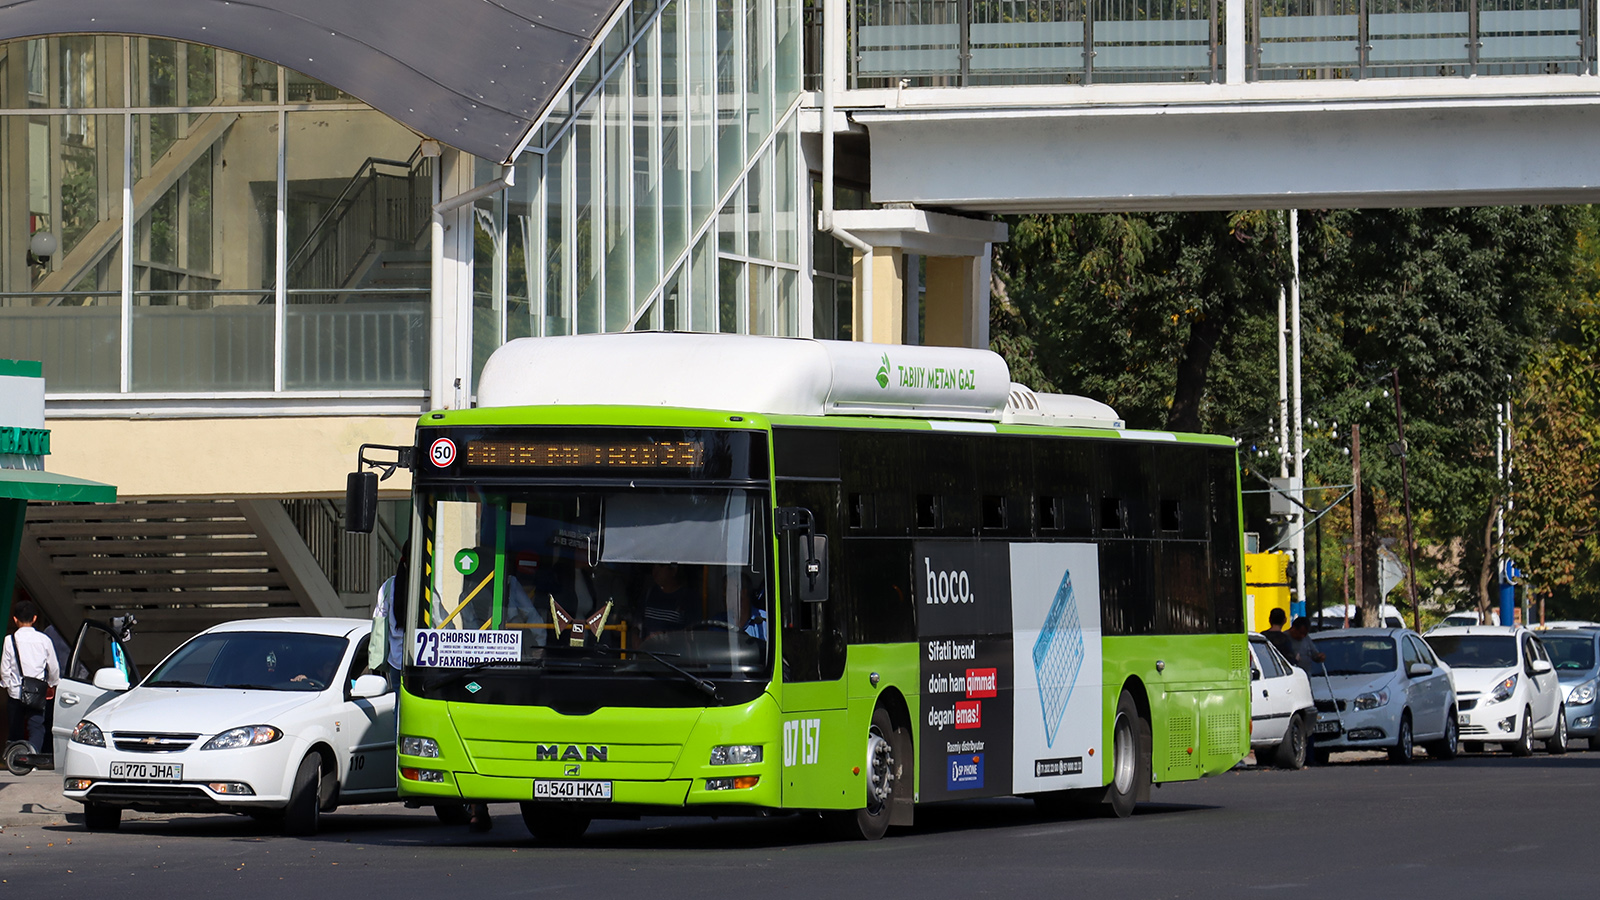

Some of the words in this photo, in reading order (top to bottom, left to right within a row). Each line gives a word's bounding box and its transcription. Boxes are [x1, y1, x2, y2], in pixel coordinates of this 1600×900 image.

[898, 366, 926, 388] TABIIY
[927, 368, 957, 390] METAN
[958, 368, 976, 391] GAZ
[434, 446, 451, 459] 50
[924, 556, 975, 605] hoco.
[416, 631, 439, 667] 23
[440, 632, 476, 644] CHORSU
[478, 633, 519, 644] METROSI
[928, 640, 951, 661] Sifatli
[952, 639, 975, 660] brend
[928, 673, 948, 694] doim
[949, 672, 966, 693] ham
[966, 671, 996, 696] qimmat
[928, 704, 955, 731] degani
[955, 703, 979, 724] emas!
[536, 744, 609, 762] MAN
[783, 720, 799, 767] 07
[800, 718, 821, 765] 157
[113, 765, 124, 776] 01
[126, 764, 147, 777] 770
[149, 764, 173, 778] JHA
[349, 755, 365, 771] 110
[537, 783, 549, 794] 01
[551, 782, 574, 796] 540
[577, 783, 604, 796] HKA
